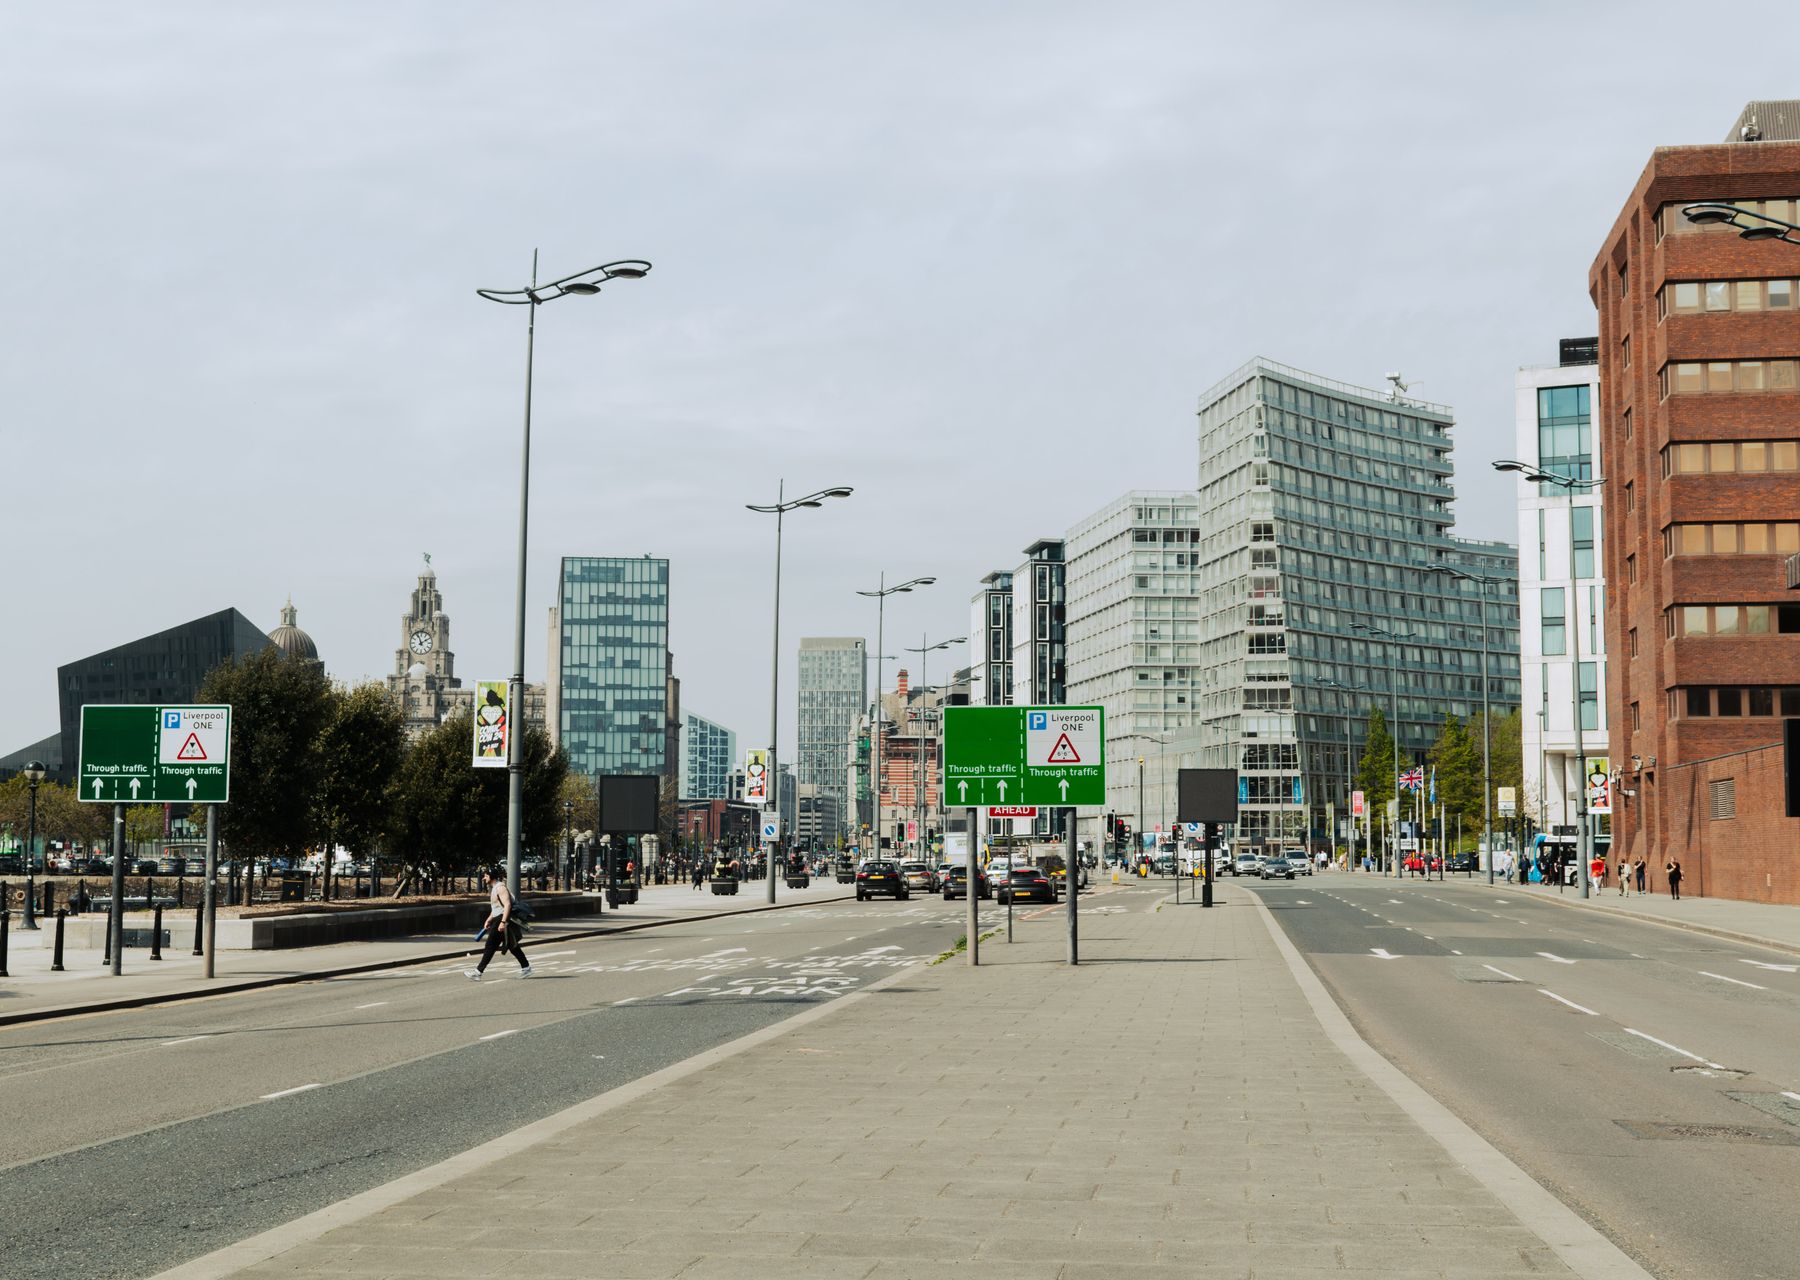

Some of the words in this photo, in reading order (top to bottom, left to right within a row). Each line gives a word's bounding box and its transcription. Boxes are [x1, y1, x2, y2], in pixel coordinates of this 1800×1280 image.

[168, 713, 178, 727] P
[183, 711, 224, 720] Liverpool
[1051, 714, 1094, 723] Liverpool
[1033, 715, 1044, 728] P
[86, 764, 120, 773] Through
[122, 764, 147, 772] traffic
[161, 766, 195, 776] Through
[197, 767, 223, 775] traffic
[948, 765, 985, 774] Through
[988, 764, 1017, 773] traffic
[1029, 768, 1066, 778] Through
[1069, 768, 1098, 776] traffic
[727, 977, 860, 986] CAR
[664, 986, 857, 996] PARK
